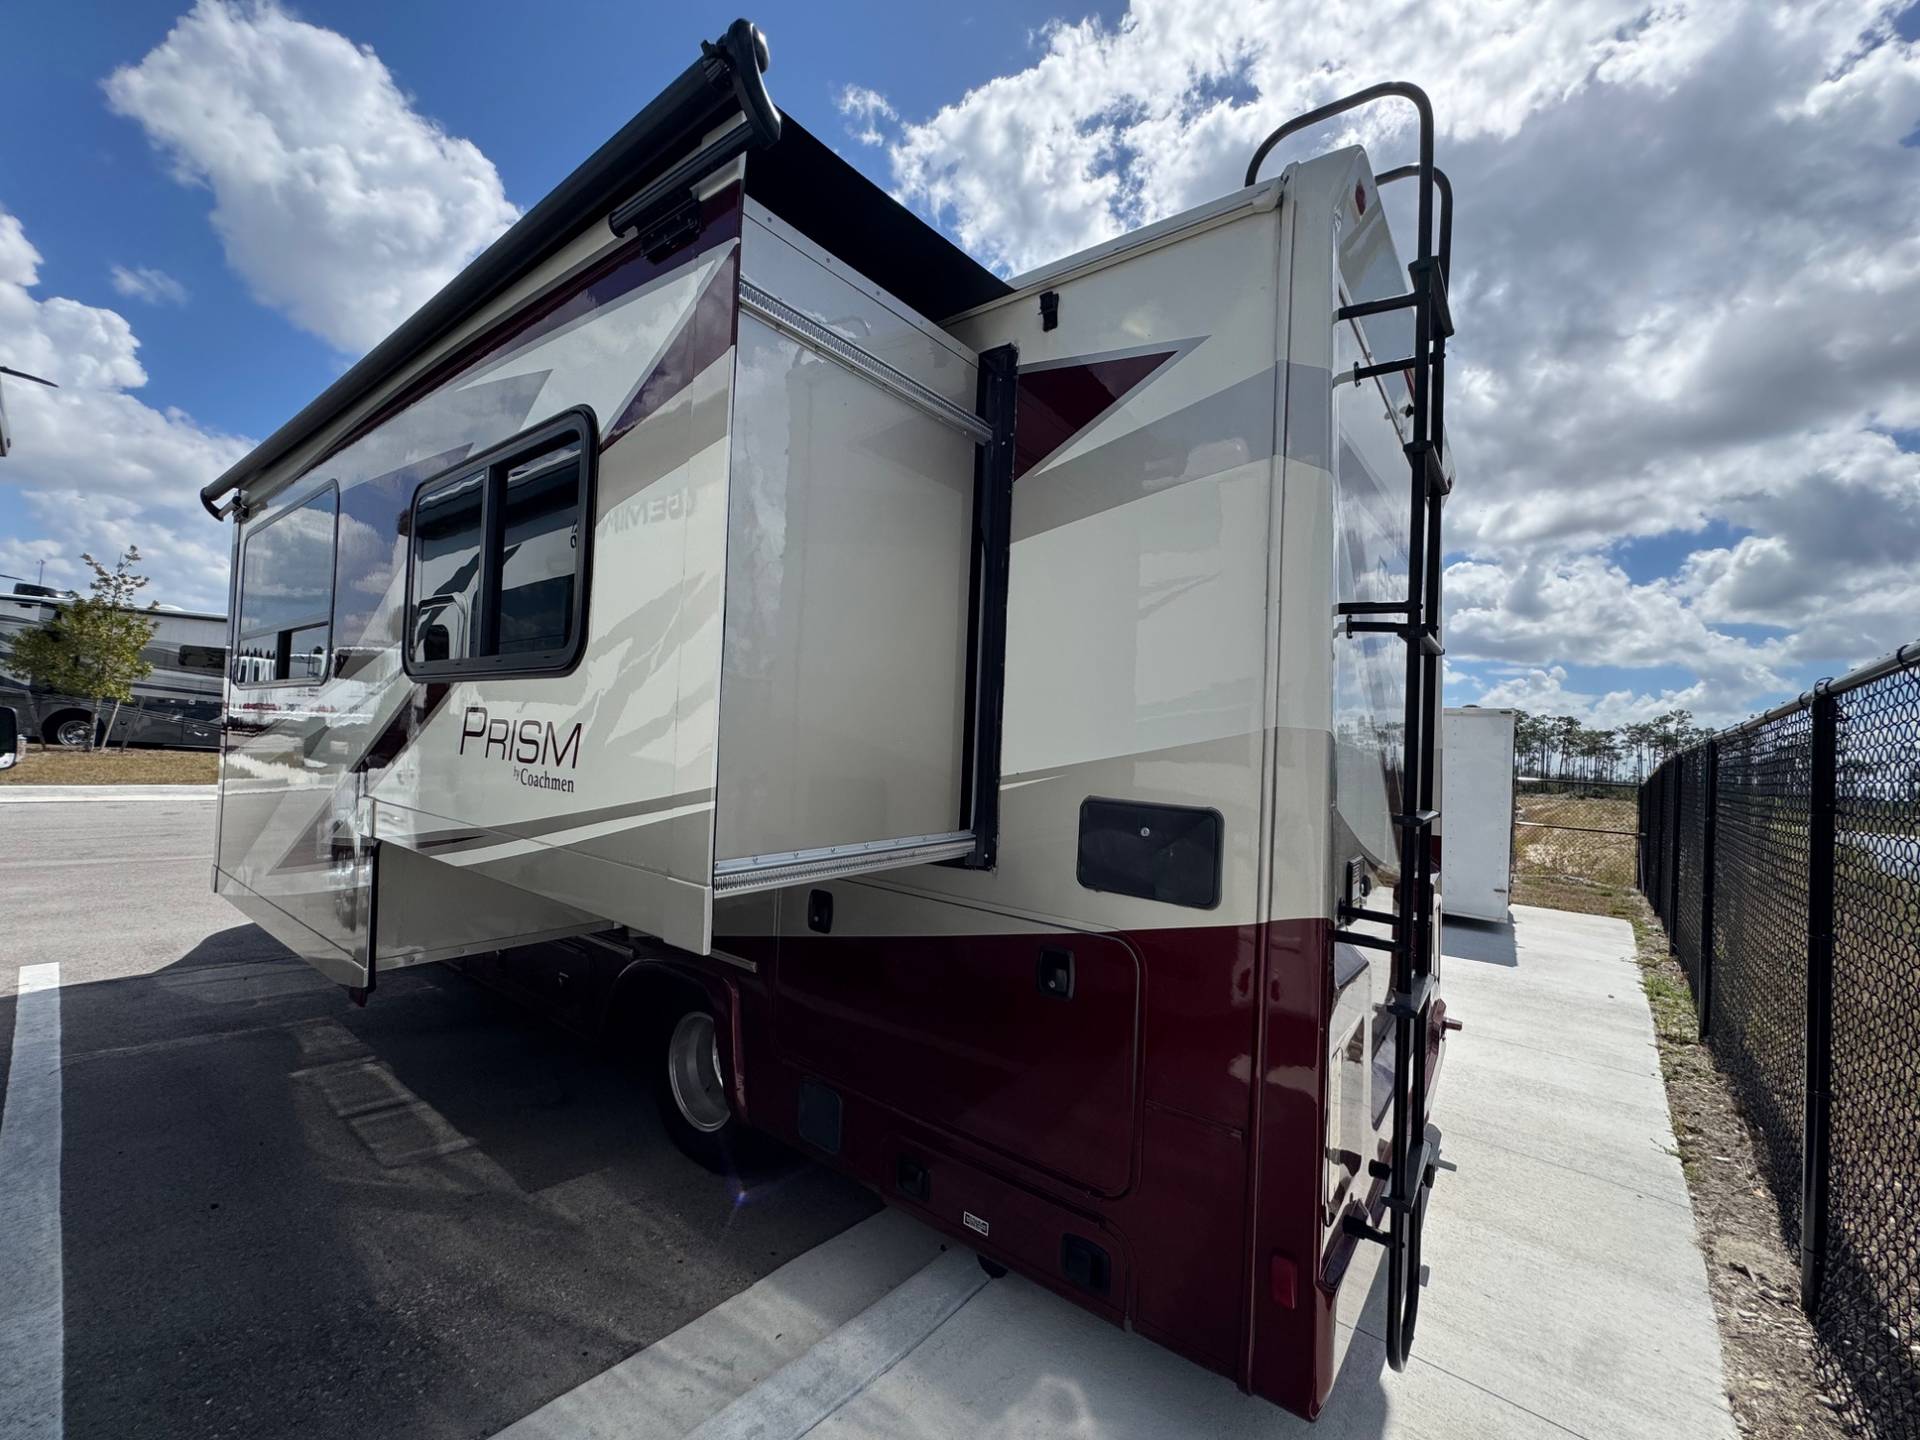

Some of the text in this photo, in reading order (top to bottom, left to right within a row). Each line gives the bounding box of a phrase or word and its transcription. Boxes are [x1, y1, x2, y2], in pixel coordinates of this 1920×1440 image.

[460, 706, 583, 769] PRISM
[512, 765, 575, 793] by Coachmen
